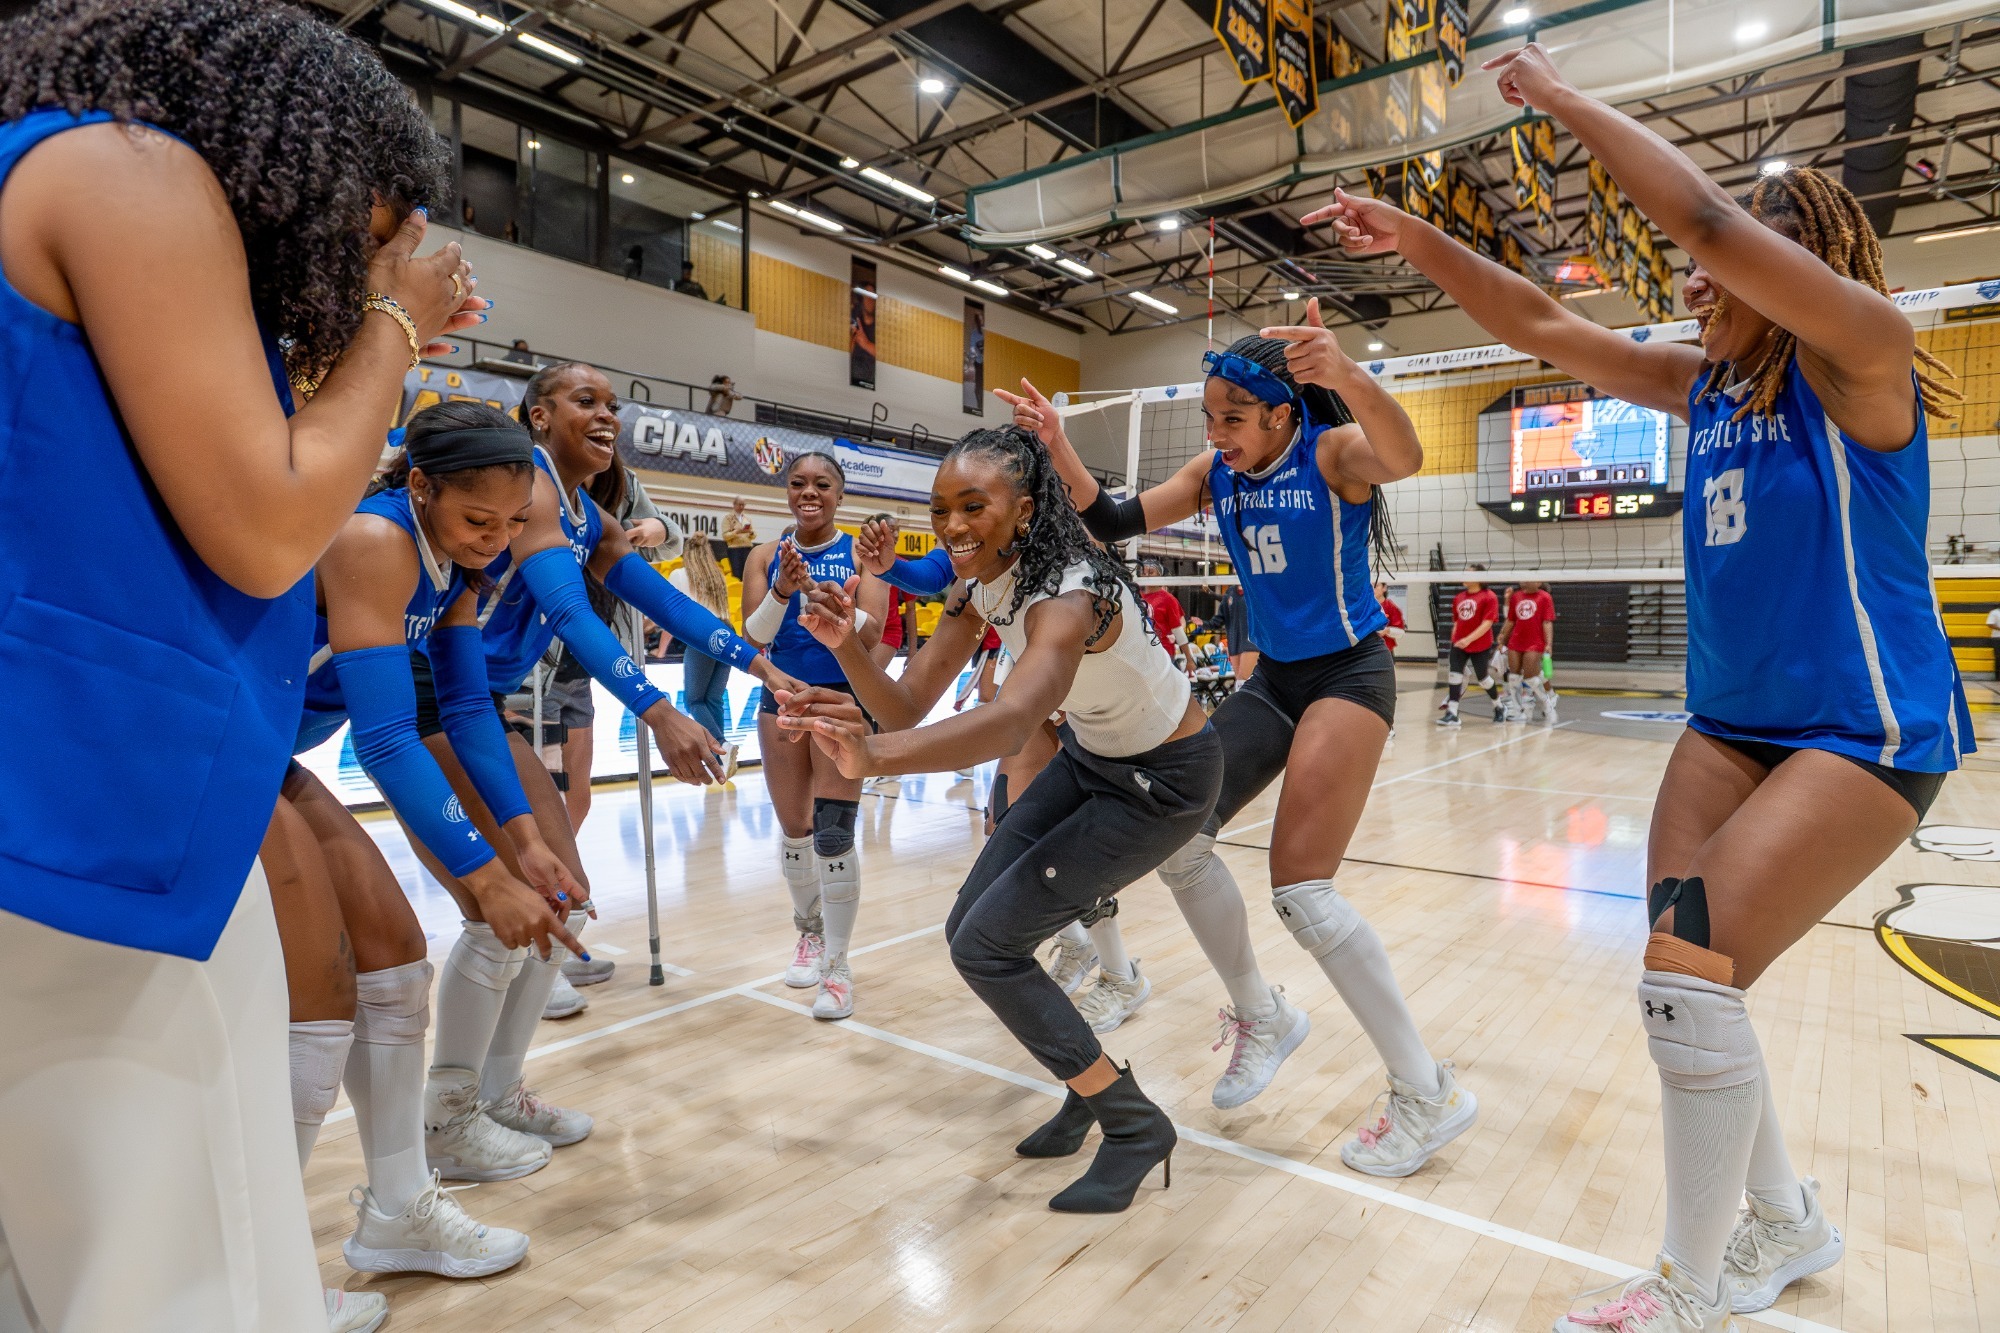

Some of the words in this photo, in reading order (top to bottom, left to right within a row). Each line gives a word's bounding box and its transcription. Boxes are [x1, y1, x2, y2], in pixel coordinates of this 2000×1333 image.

[1407, 356, 1431, 368] CIAA
[1436, 348, 1504, 364] VOLLEYBALL
[633, 416, 728, 465] CIAA
[840, 458, 884, 477] Academy
[1279, 489, 1316, 511] STATE
[1538, 499, 1561, 518] 21
[1615, 494, 1639, 514] 25
[1703, 468, 1748, 547] 18
[693, 514, 718, 537] 104
[904, 534, 922, 552] 104
[1242, 524, 1288, 575] 16
